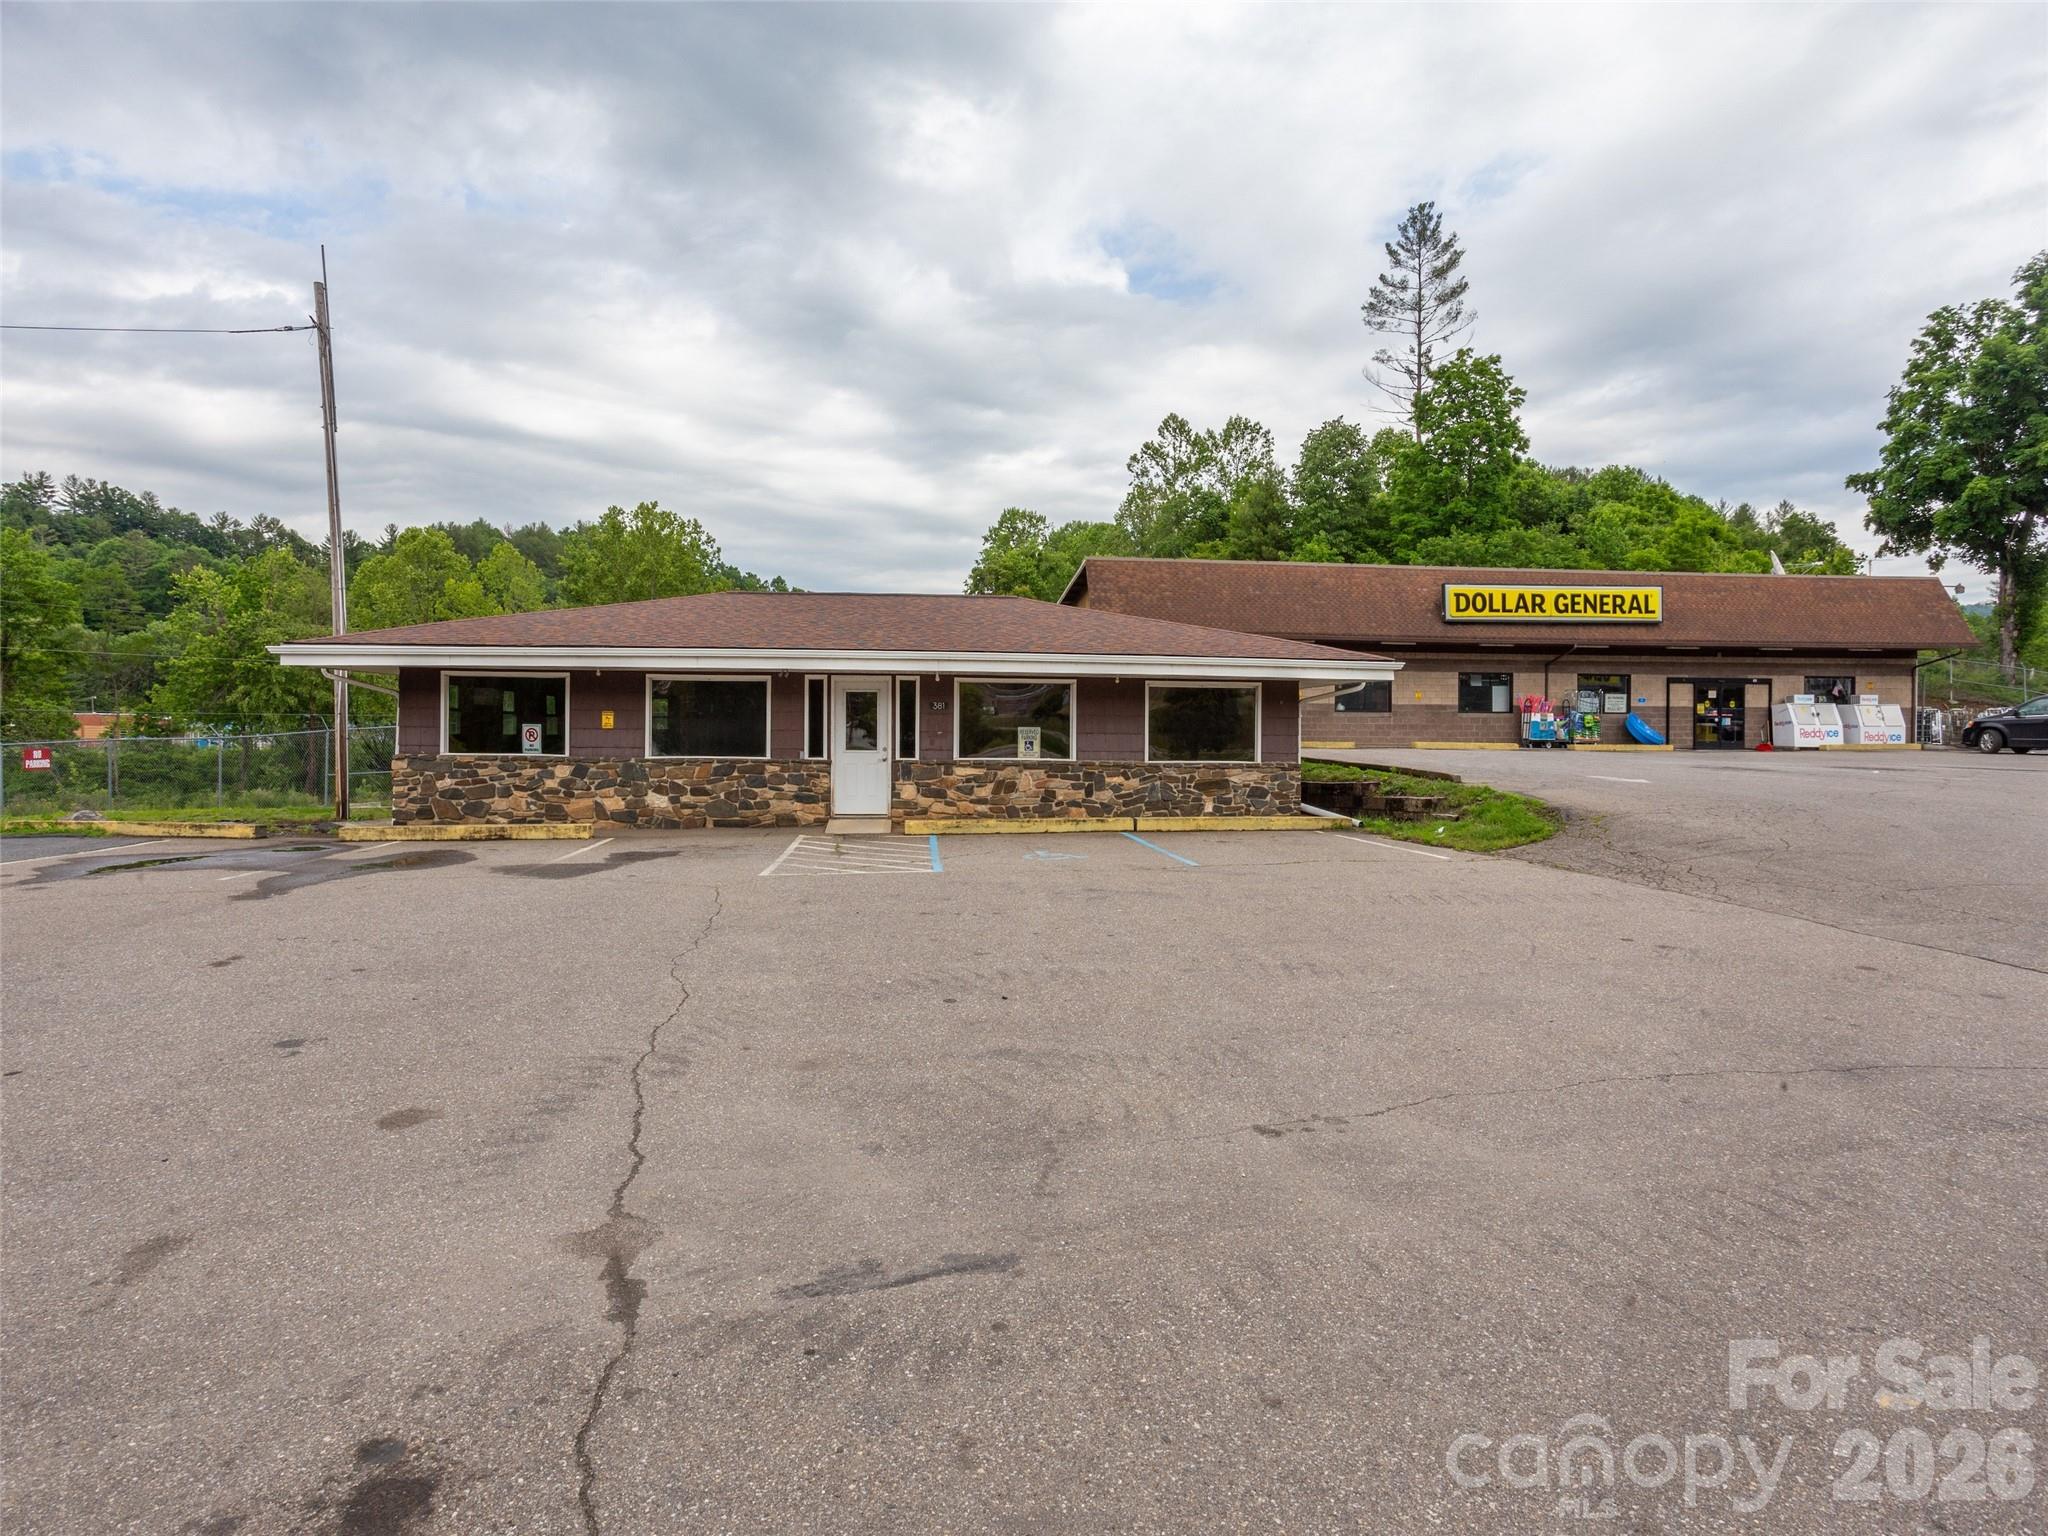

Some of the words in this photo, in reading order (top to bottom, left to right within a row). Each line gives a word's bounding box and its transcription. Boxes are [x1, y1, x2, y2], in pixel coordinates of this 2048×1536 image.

[1453, 592, 1546, 614] DOLLAR
[1553, 593, 1656, 615] GENERAL
[931, 701, 945, 710] 381
[33, 750, 42, 759] NO
[25, 759, 50, 769] PARKING
